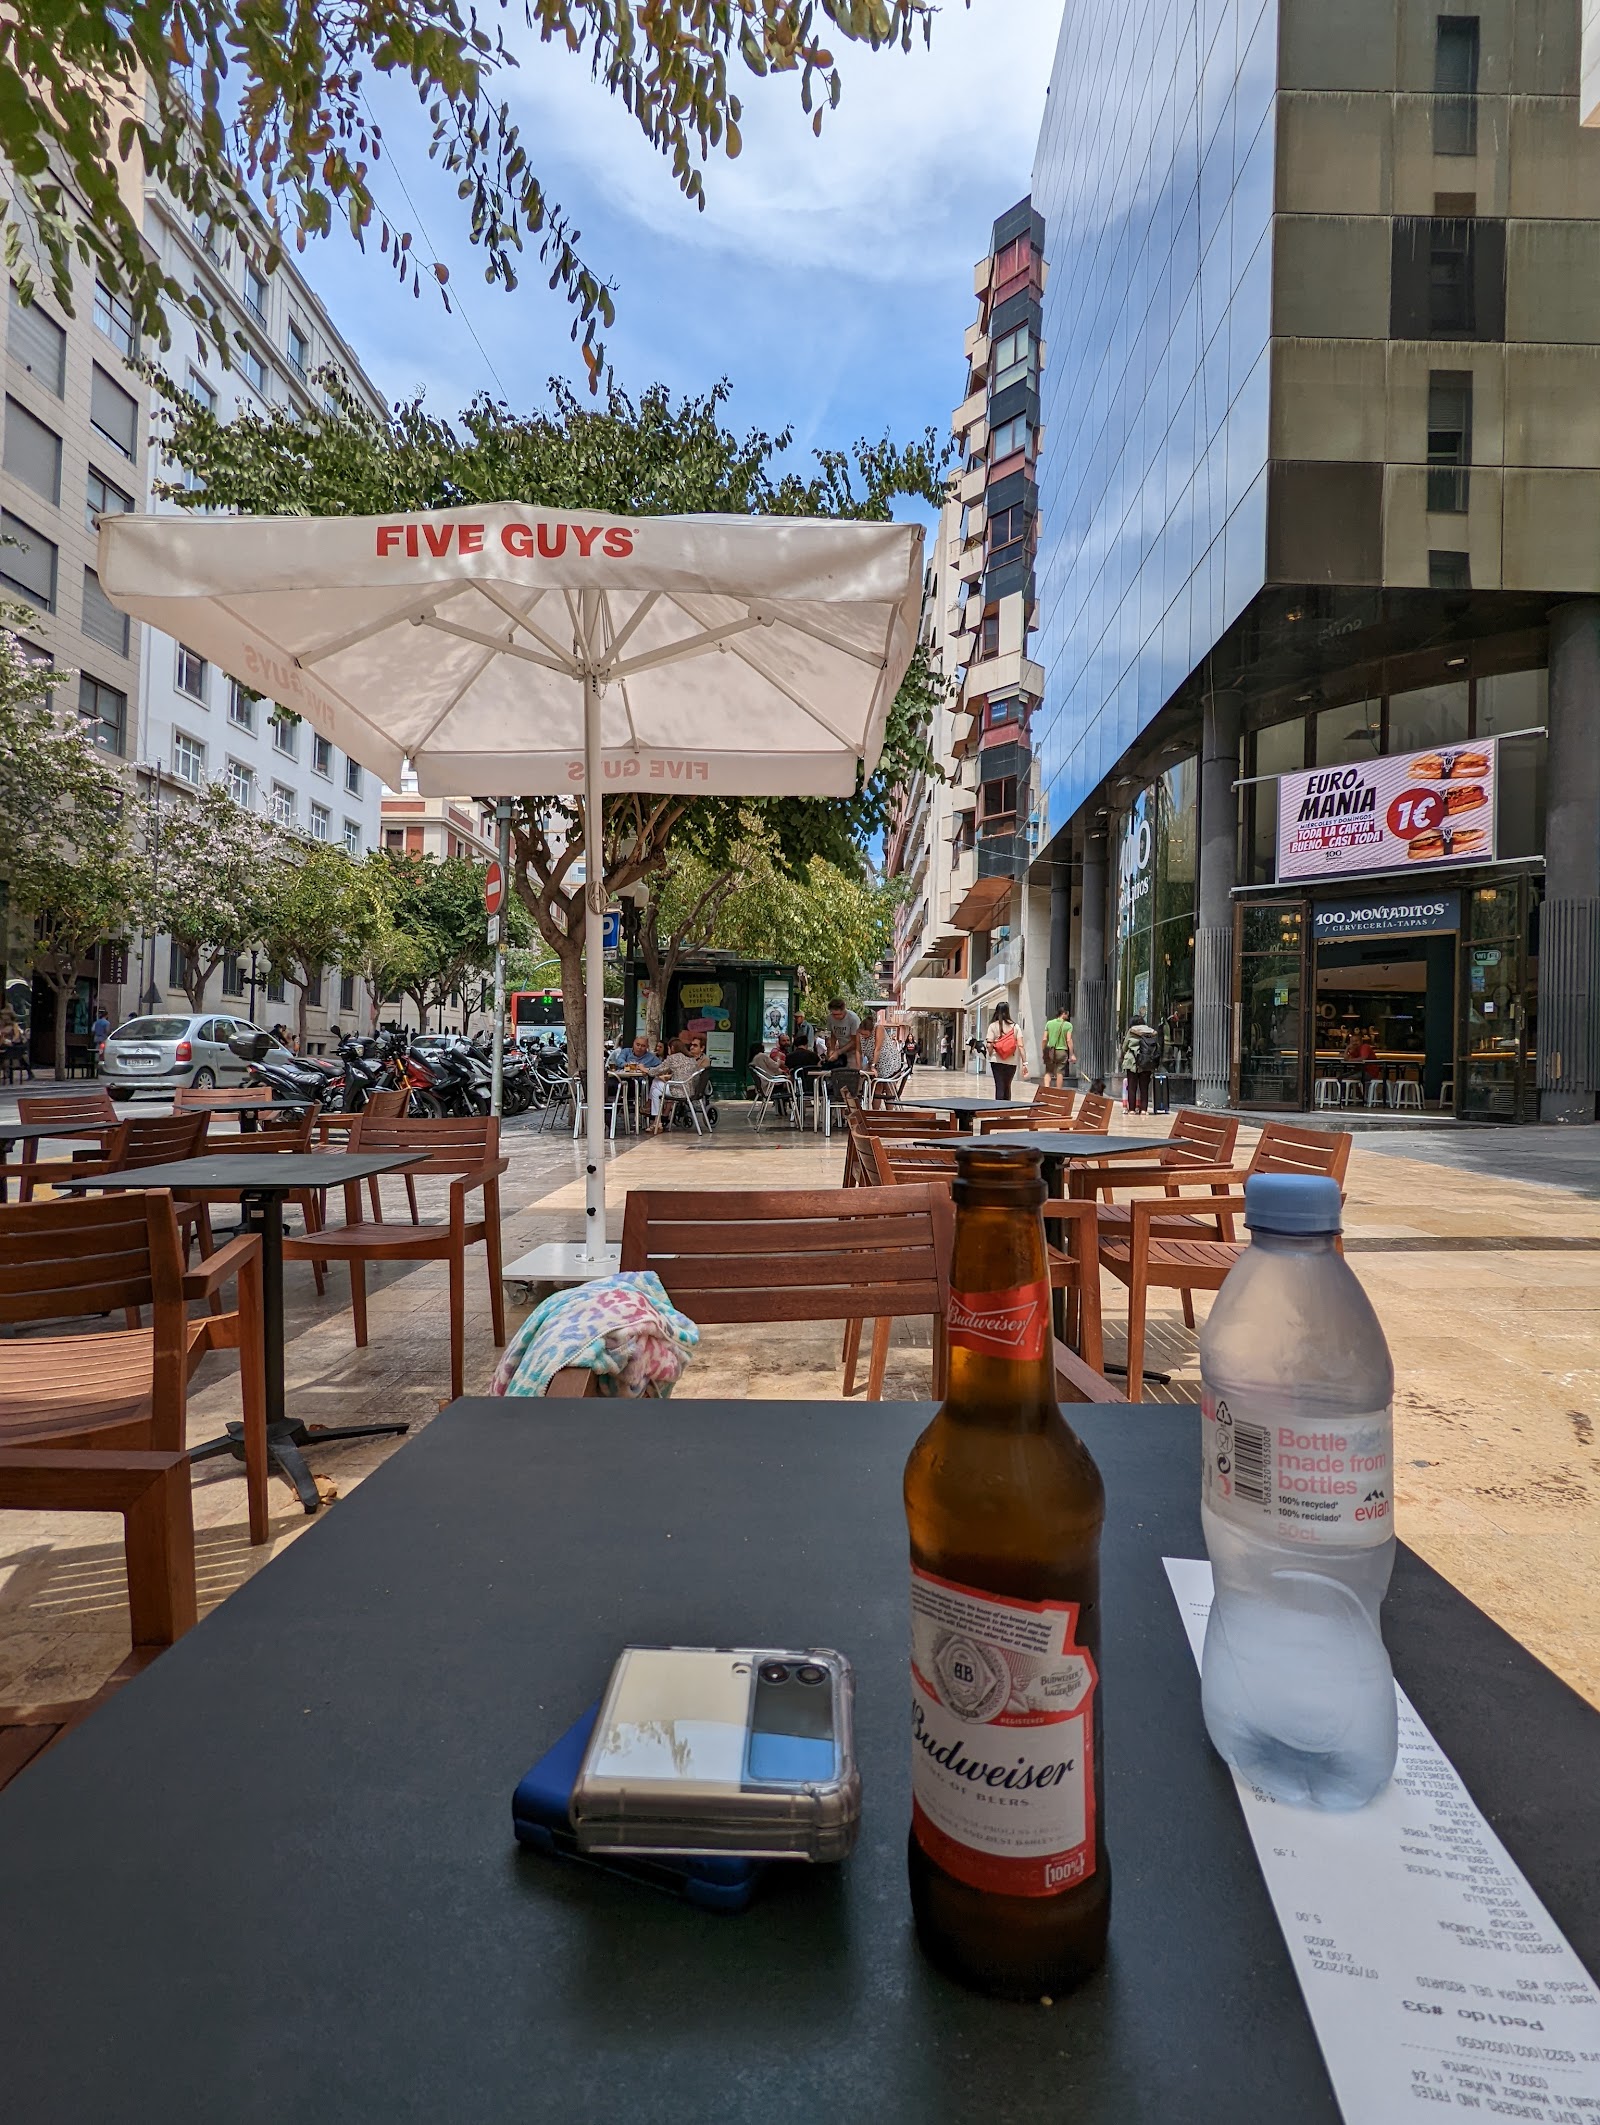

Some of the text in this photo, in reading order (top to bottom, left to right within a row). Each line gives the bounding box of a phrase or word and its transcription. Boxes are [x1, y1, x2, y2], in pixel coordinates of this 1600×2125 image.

[377, 523, 634, 558] FIVE GUYS
[1306, 769, 1358, 796] EURO
[1297, 778, 1377, 822] MANÍA
[1339, 813, 1372, 824] DOMINGOS
[1398, 797, 1436, 830] 1€
[1298, 827, 1323, 841] TODA
[1325, 825, 1337, 837] LA
[1354, 830, 1380, 845] TODA
[1325, 850, 1342, 858] 100
[1315, 902, 1445, 926] 100 MONTADITOS
[947, 1303, 1029, 1332] Budweiser
[1278, 1427, 1347, 1451] Bottle
[1278, 1452, 1386, 1474] made from
[1278, 1471, 1357, 1495] bottles
[1278, 1495, 1300, 1507] 100%
[1354, 1499, 1389, 1522] evian
[1278, 1508, 1300, 1519] 100%
[912, 1699, 1075, 1790] Budweiser
[1398, 1742, 1434, 1752] Subtota
[1296, 1911, 1322, 1923] 5.00
[1327, 1951, 1354, 1964] 2:00
[1312, 1959, 1379, 1980] 07/05/2022
[1416, 1976, 1466, 1994] ROSARIO
[1470, 1984, 1493, 1998] DEL
[1544, 1981, 1588, 1992] Pedido
[1402, 2000, 1545, 2032] Pedido #93
[1411, 2070, 1430, 2084] 24
[1440, 2060, 1500, 2080] Alicante
[1411, 2085, 1452, 2103] FRIES
[1456, 2092, 1480, 2109] AND
[1486, 2098, 1544, 2121] BURGERS
